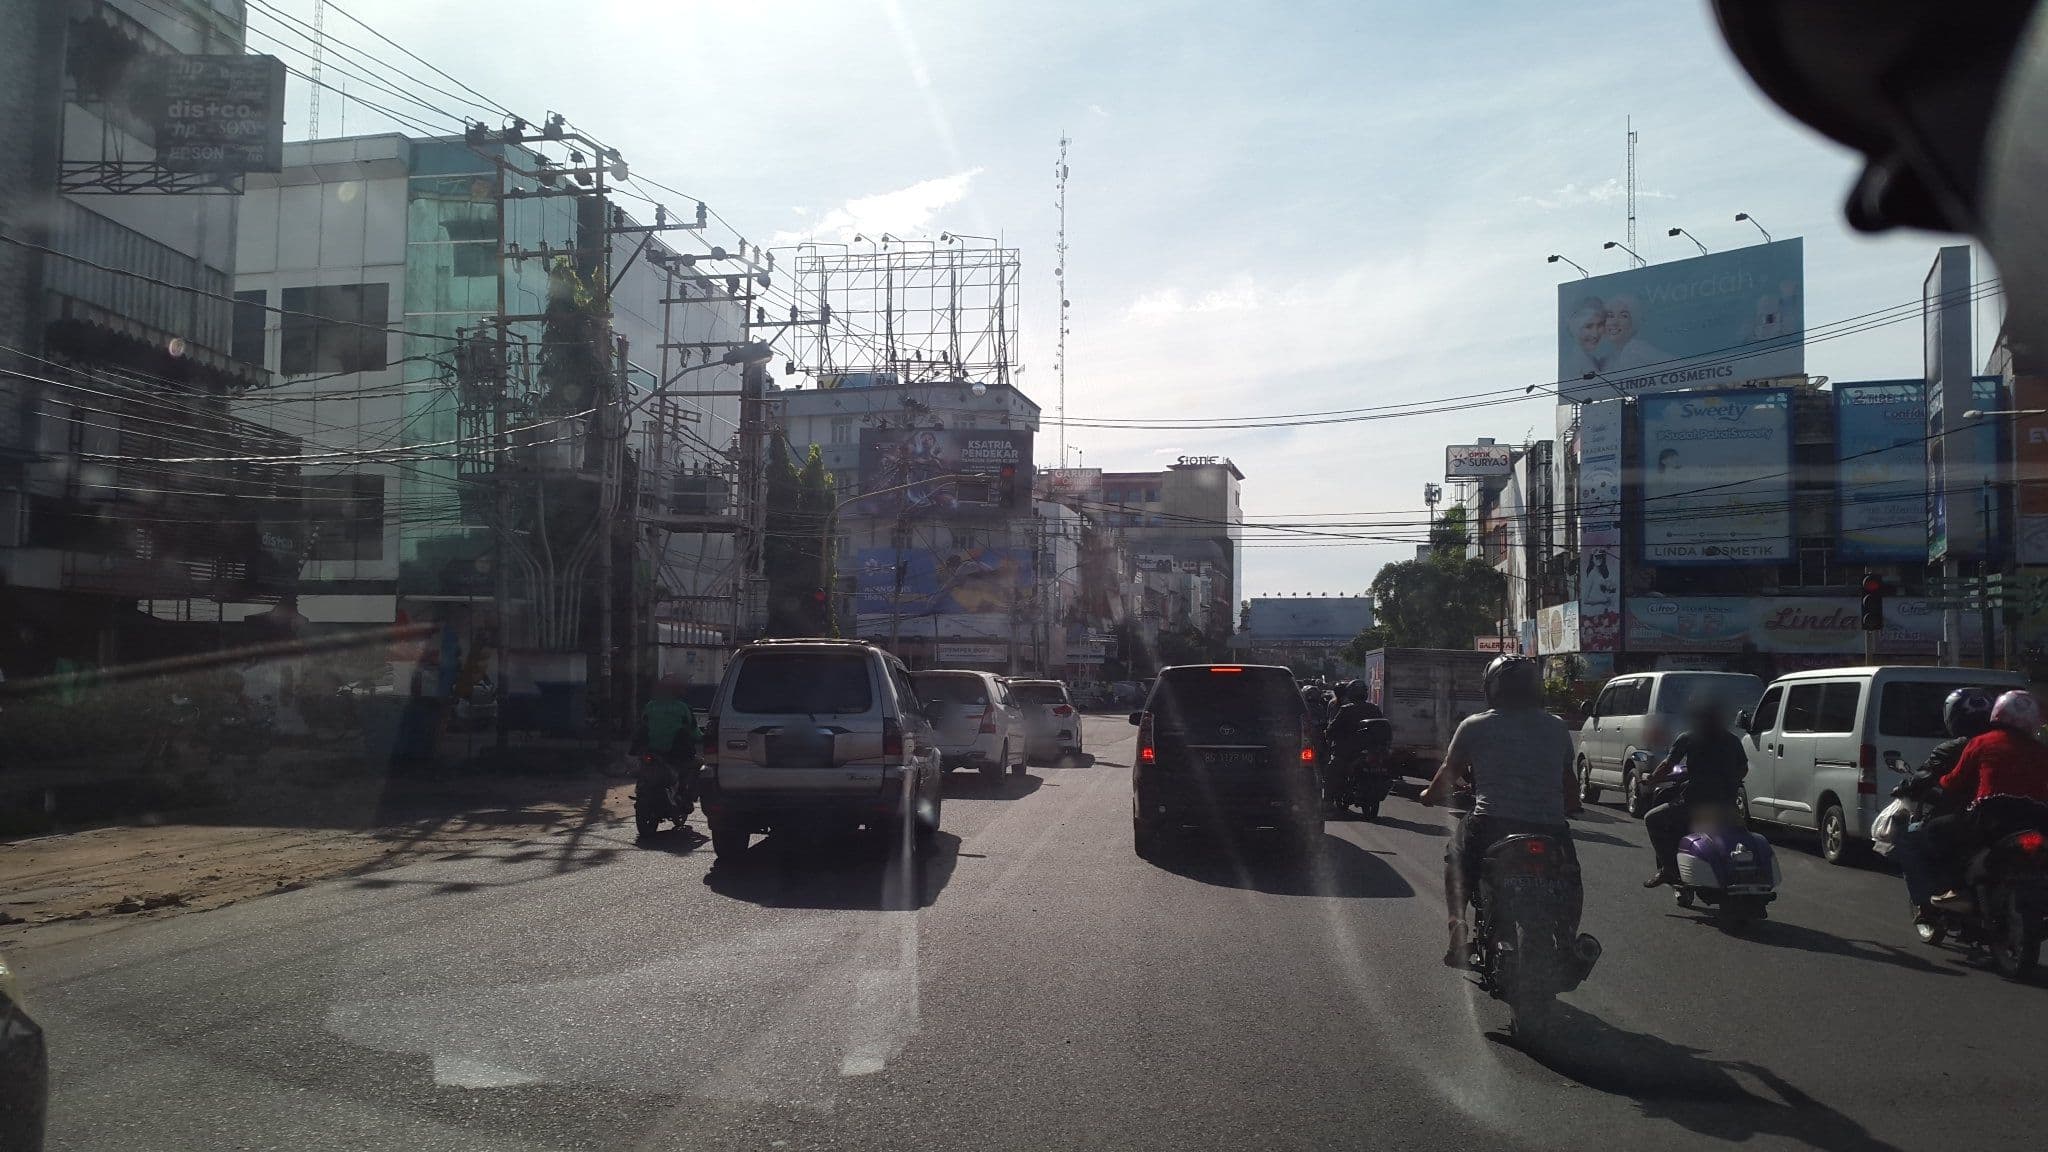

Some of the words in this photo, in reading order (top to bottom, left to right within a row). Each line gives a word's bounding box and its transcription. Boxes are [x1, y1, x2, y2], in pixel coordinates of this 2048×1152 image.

[1644, 266, 1753, 306] Wardah
[1619, 374, 1658, 391] LINDA
[1661, 365, 1734, 387] COSMETICS
[1681, 403, 1747, 422] Sweety
[968, 440, 1012, 449] KSATRIA
[961, 449, 1018, 458] PENDEKAR
[1055, 469, 1100, 478] GARUDA
[1655, 546, 1697, 557] LINDA
[1765, 607, 1860, 631] Linda
